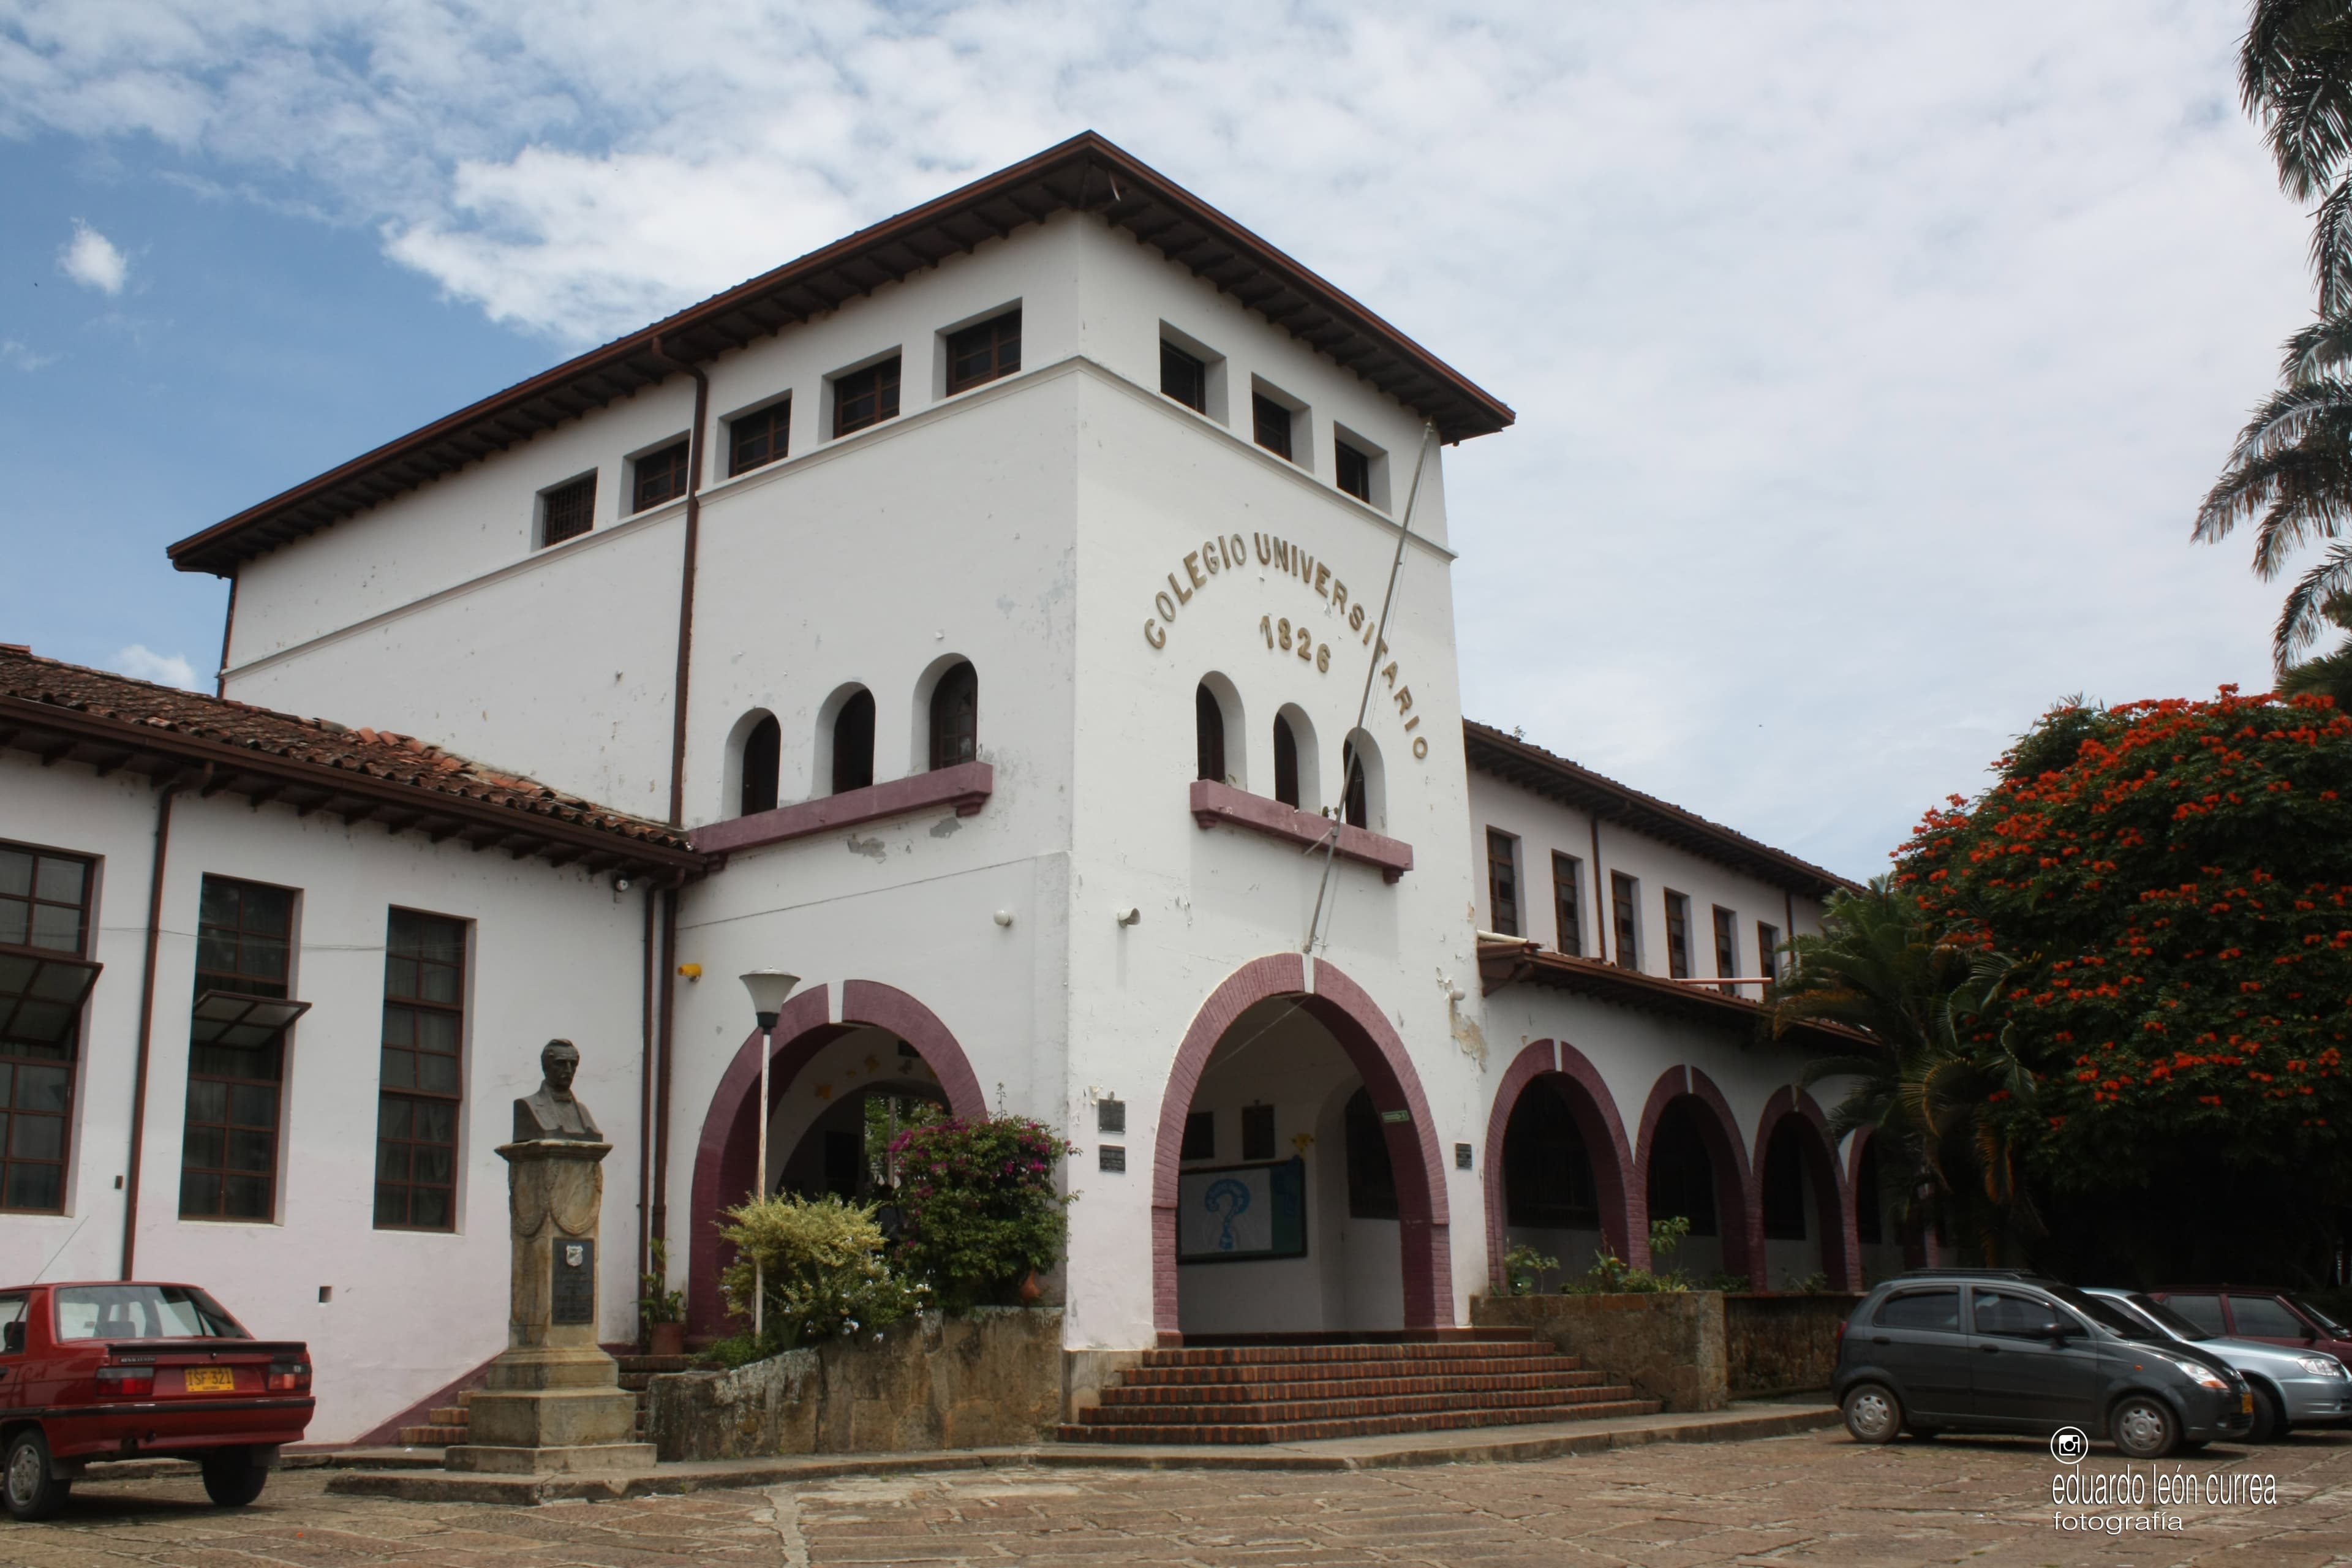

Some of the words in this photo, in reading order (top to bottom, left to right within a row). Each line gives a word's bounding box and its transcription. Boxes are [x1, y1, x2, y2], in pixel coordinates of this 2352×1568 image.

[1145, 533, 1246, 649] COLEGIO
[1259, 615, 1331, 673] 1826
[211, 1367, 232, 1385] 321
